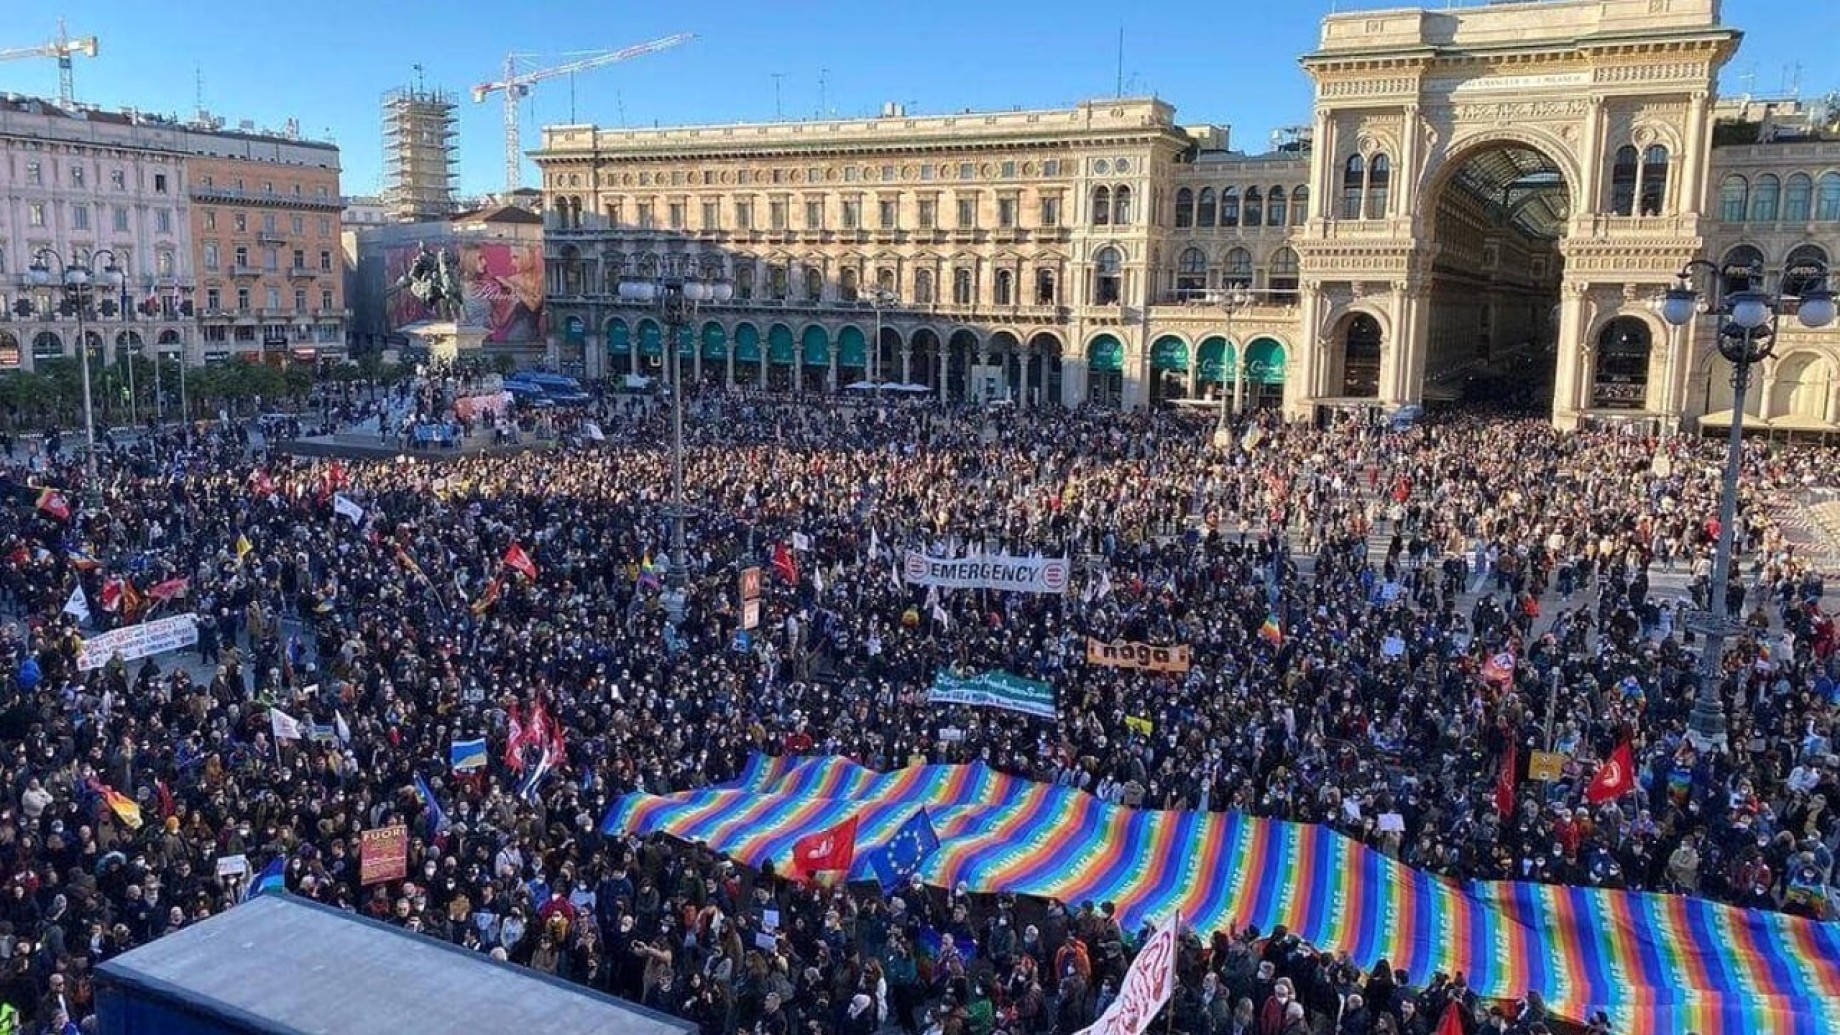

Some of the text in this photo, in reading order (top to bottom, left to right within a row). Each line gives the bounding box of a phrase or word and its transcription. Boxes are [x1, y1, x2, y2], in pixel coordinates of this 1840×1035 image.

[745, 573, 759, 592] M
[931, 562, 1039, 583] EMERGENCY
[1103, 645, 1170, 666] naga
[1286, 828, 1300, 865] PACE
[1330, 890, 1346, 924] PACE
[1384, 901, 1399, 937] PACE
[1593, 891, 1616, 931] PACE
[1439, 912, 1454, 948] PACE
